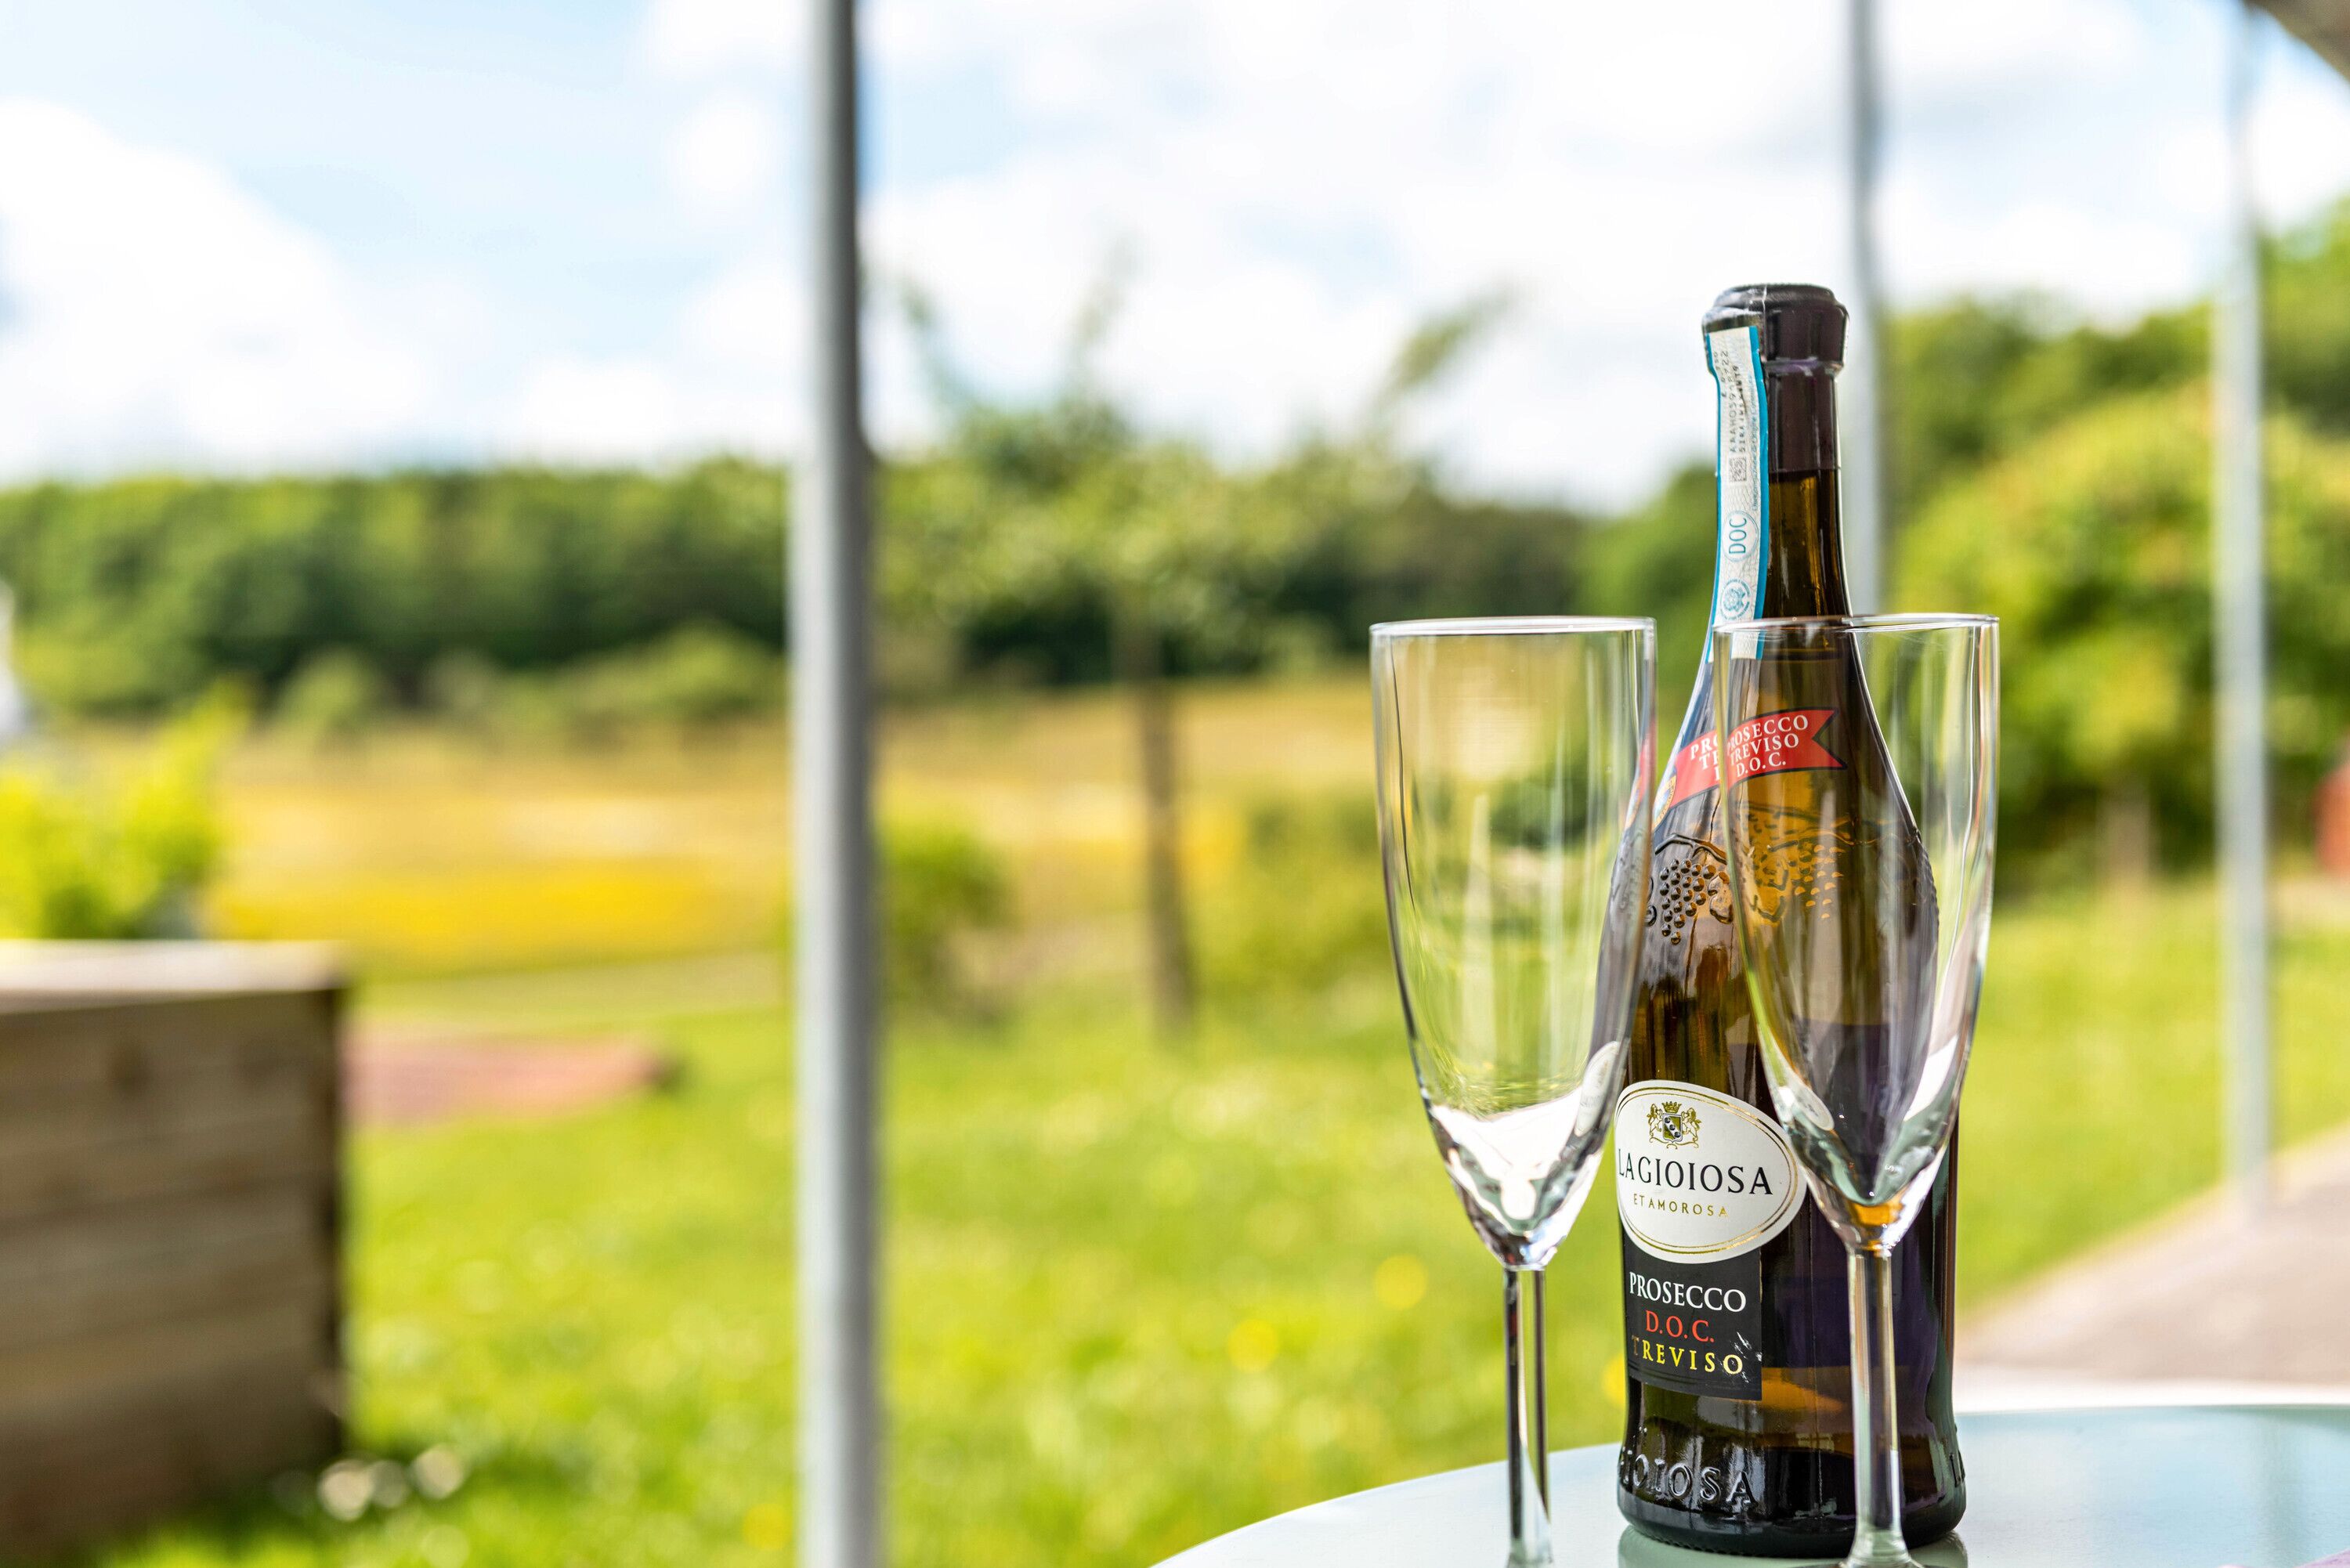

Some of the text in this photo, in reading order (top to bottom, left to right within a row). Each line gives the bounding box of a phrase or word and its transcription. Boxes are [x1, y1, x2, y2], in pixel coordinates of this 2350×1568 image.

[1729, 517, 1748, 555] DOC
[1726, 714, 1809, 757] PROSECCO
[1730, 732, 1799, 766] TREVISO
[1736, 752, 1787, 778] D.O.C.
[1629, 1271, 1747, 1313] PROSECCO
[1646, 1310, 1715, 1342] D.O.C.
[1632, 1335, 1744, 1375] TREVISO
